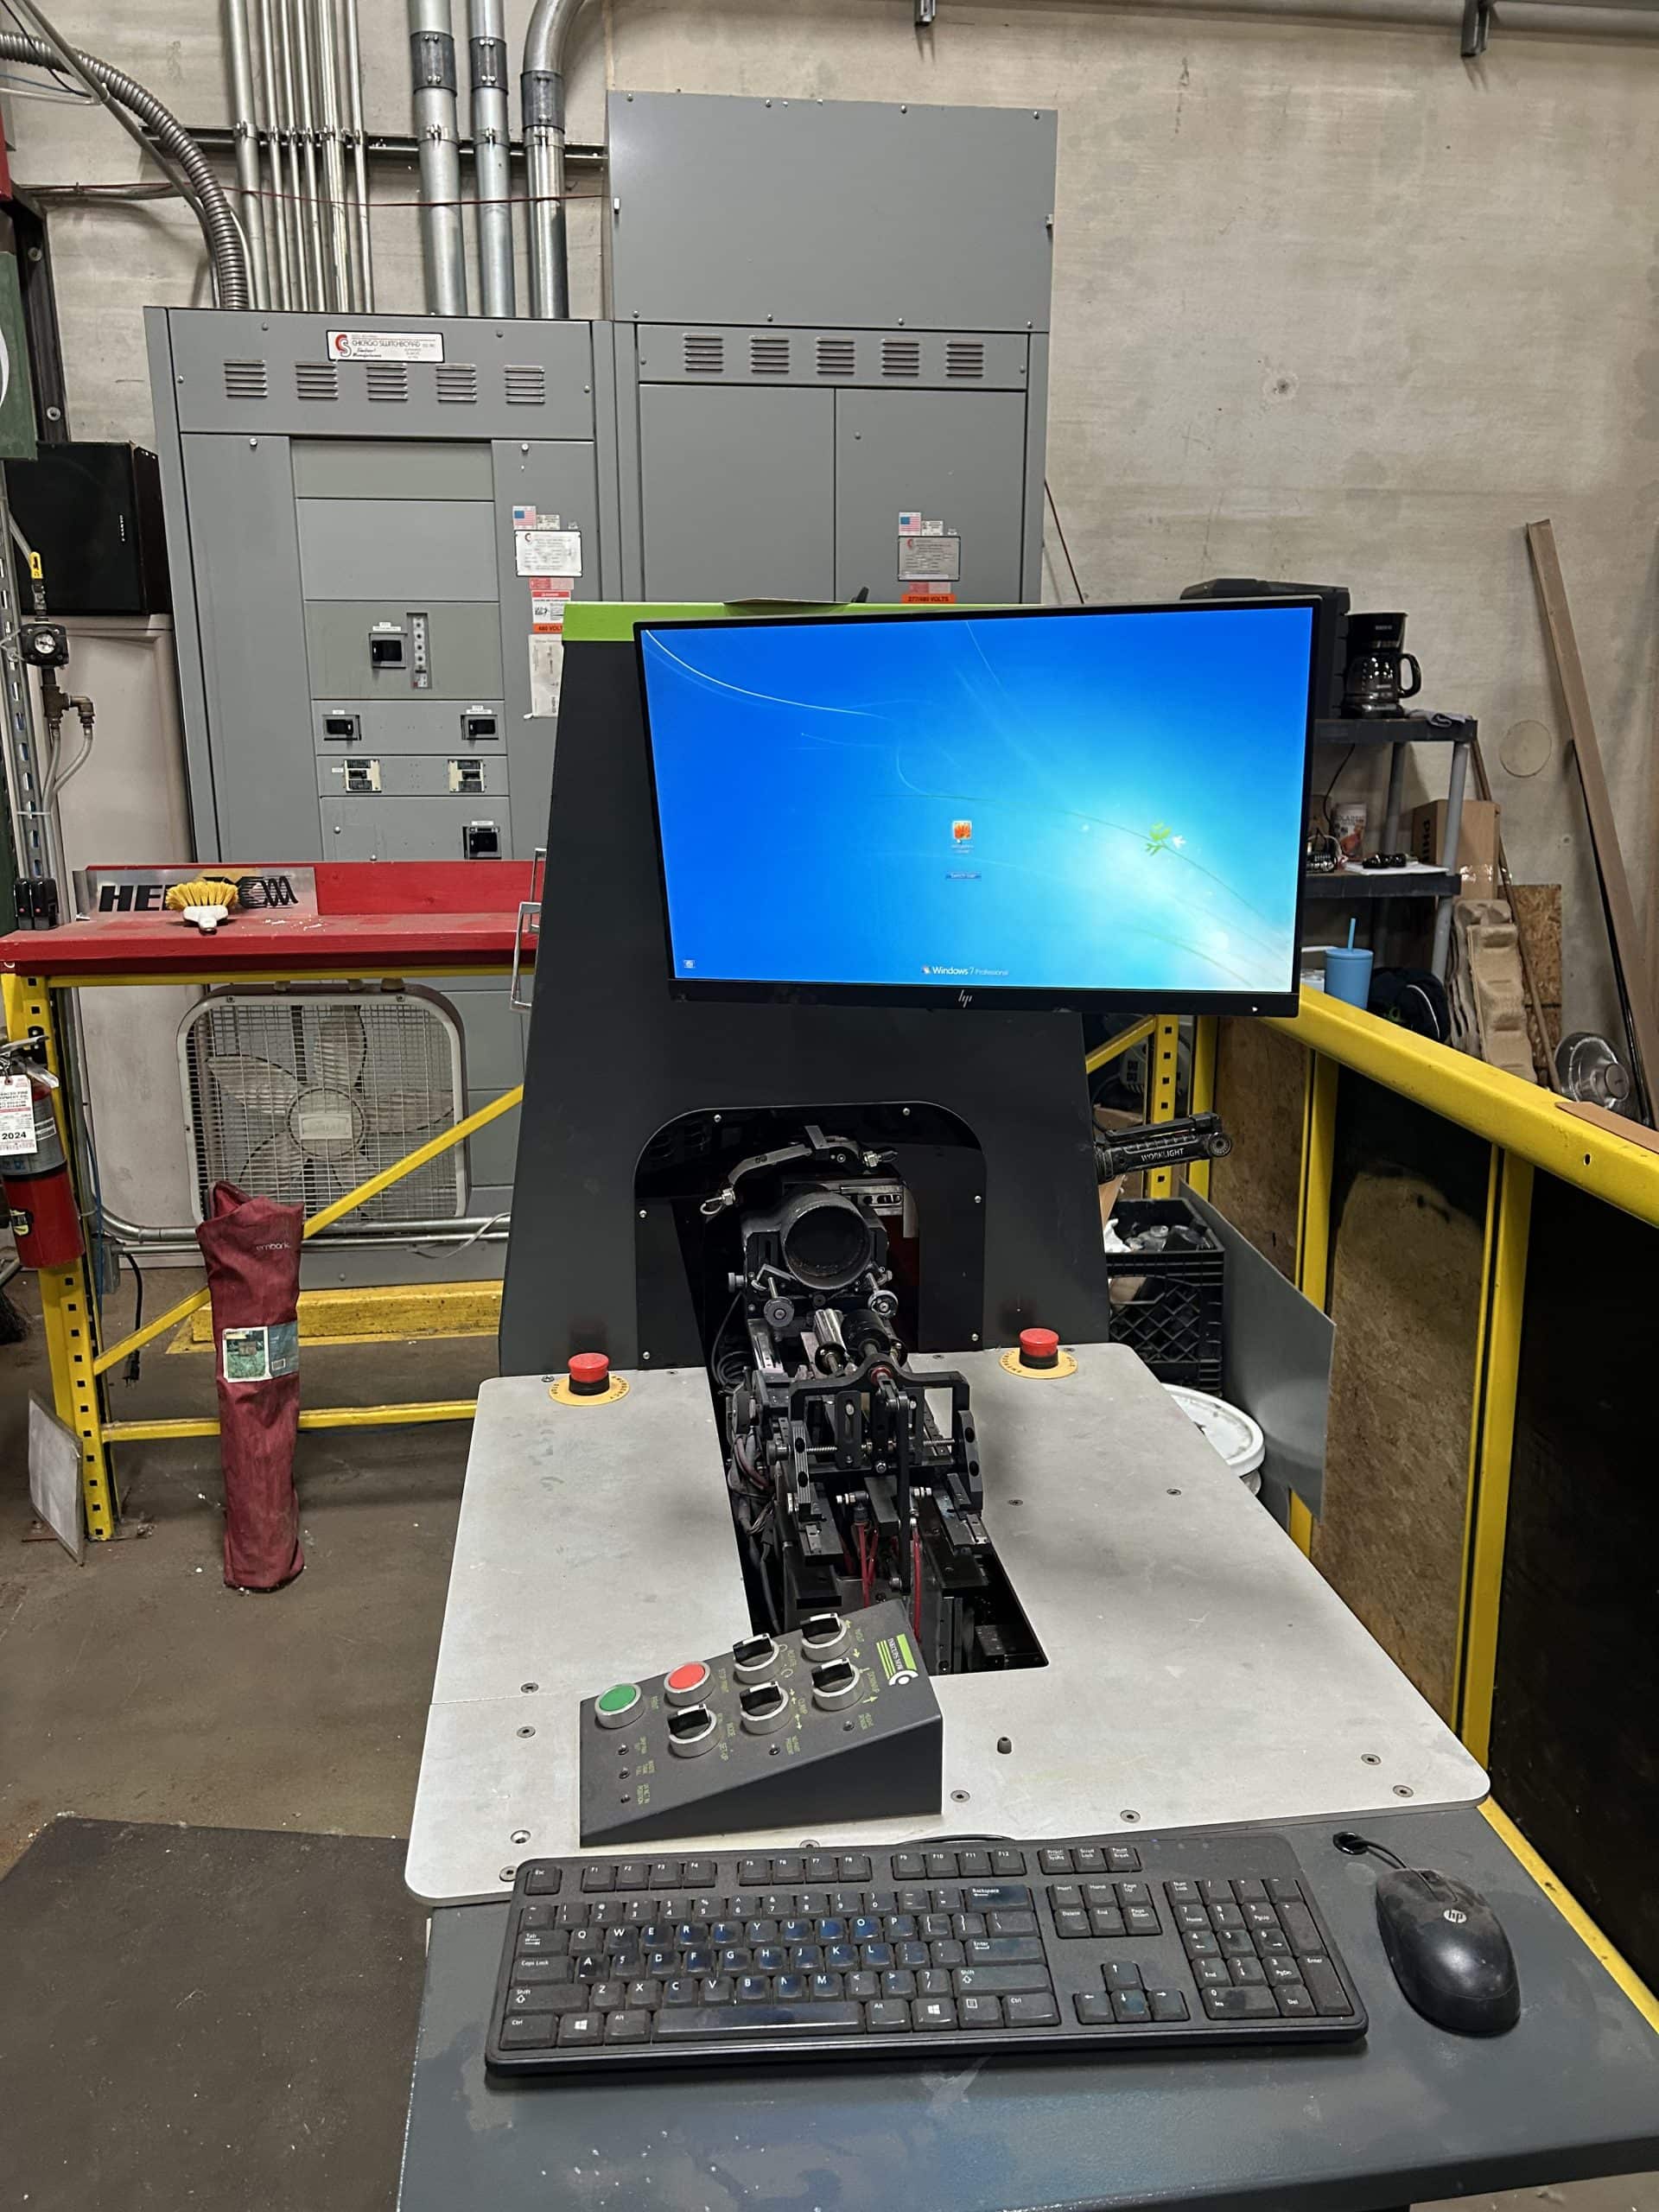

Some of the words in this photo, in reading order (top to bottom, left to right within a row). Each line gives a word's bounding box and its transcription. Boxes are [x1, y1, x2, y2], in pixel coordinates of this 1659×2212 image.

[932, 966, 968, 975] Windows
[2, 1131, 27, 1141] 2024
[787, 1921, 795, 1929] U
[856, 1918, 865, 1927] O
[891, 1916, 898, 1925] P
[613, 1928, 626, 1936] W
[648, 1927, 655, 1936] E
[683, 1925, 690, 1934] R
[718, 1923, 725, 1932] T
[577, 1930, 587, 1939] Q
[762, 1948, 770, 1957] H
[798, 1948, 803, 1956] J
[868, 1945, 874, 1954] L
[655, 1954, 663, 1962] D
[691, 1952, 697, 1961] F
[727, 1950, 734, 1959] G
[583, 1956, 593, 1966] A
[708, 1980, 716, 1988] V
[744, 1978, 752, 1987] B
[817, 1975, 827, 1984] M
[598, 1985, 606, 1993] Z
[635, 1983, 644, 1992] X
[671, 1981, 679, 1990] C
